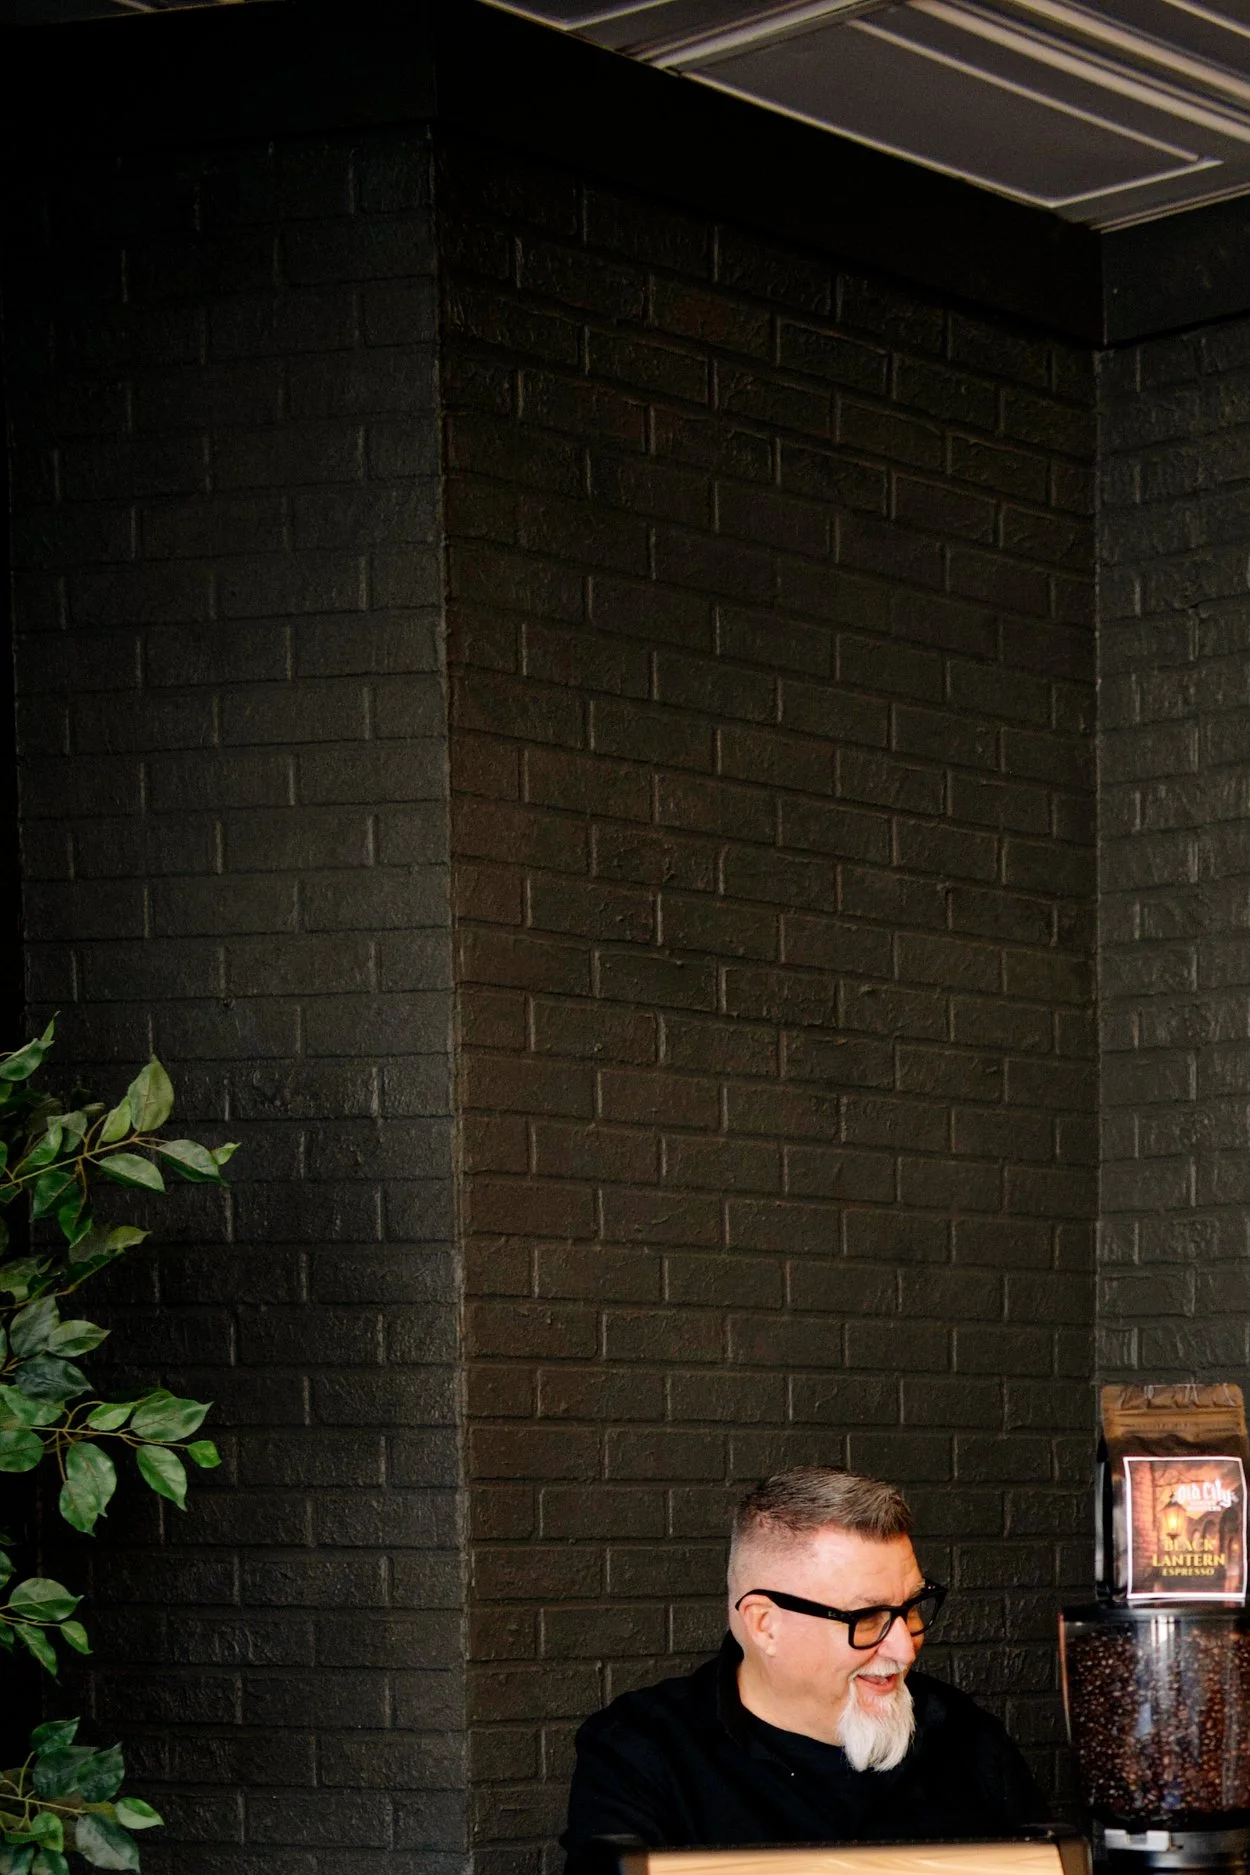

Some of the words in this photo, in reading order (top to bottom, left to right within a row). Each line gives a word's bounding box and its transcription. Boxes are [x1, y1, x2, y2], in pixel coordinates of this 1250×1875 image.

[1203, 1478, 1232, 1508] City
[1164, 1538, 1217, 1551] BLACK
[1152, 1553, 1226, 1567] LANTERN
[1162, 1567, 1215, 1577] ESPRESSO
